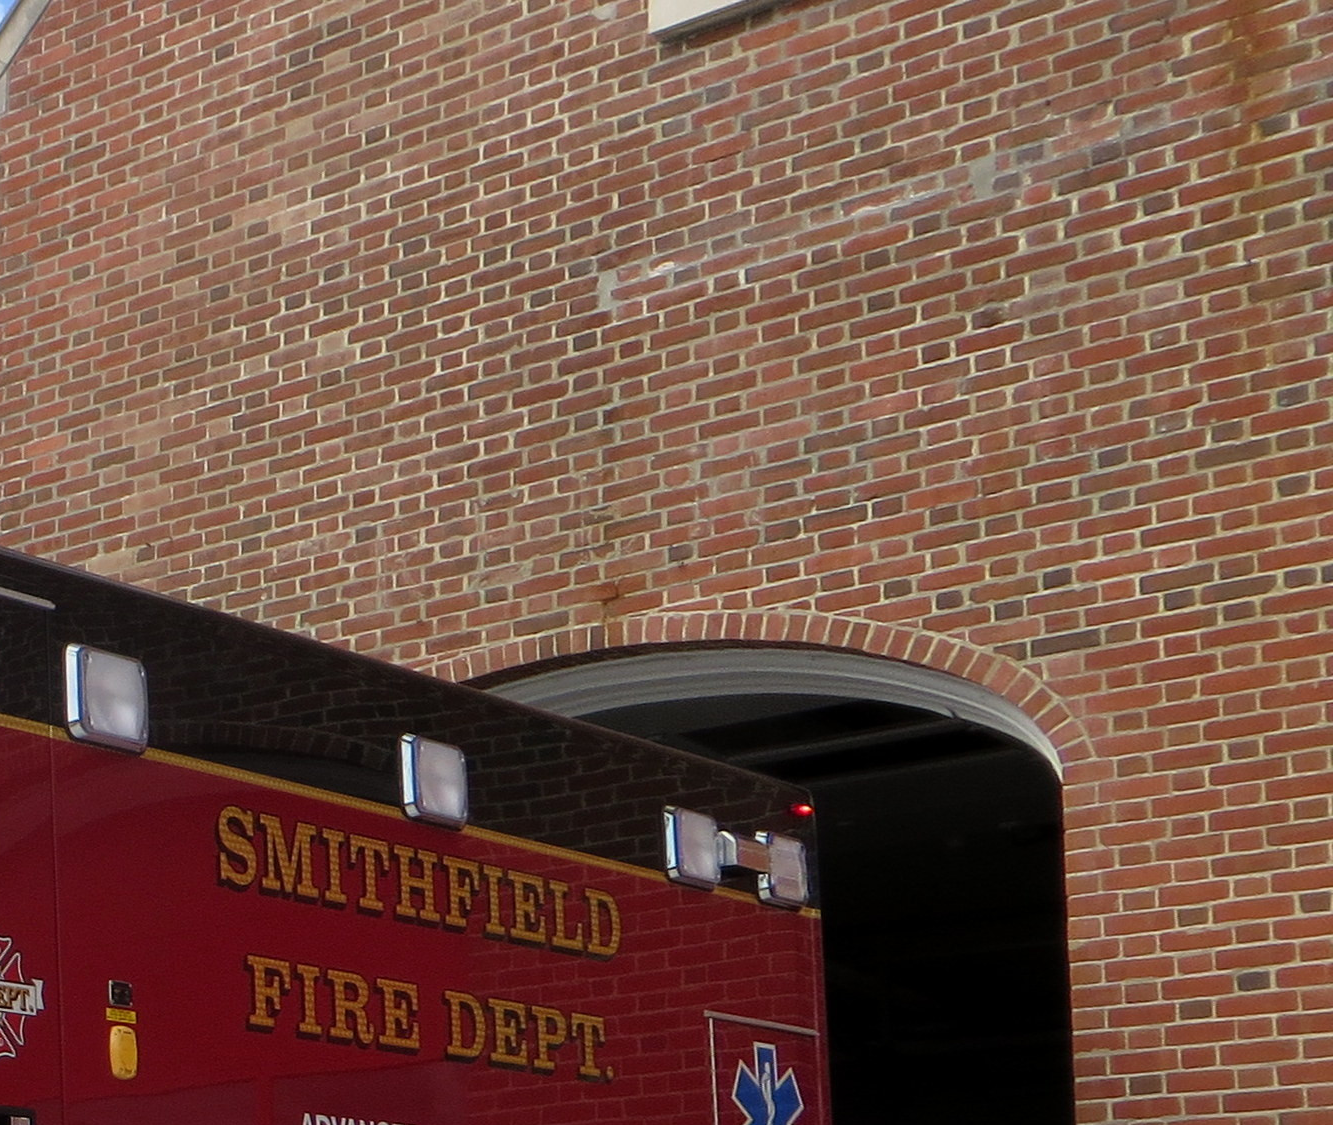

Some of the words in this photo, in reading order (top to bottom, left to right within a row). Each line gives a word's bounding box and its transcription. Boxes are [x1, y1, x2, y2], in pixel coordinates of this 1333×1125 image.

[217, 805, 622, 960] SMITHFIELD
[246, 954, 420, 1052] FIRE
[443, 990, 614, 1081] DEPT.
